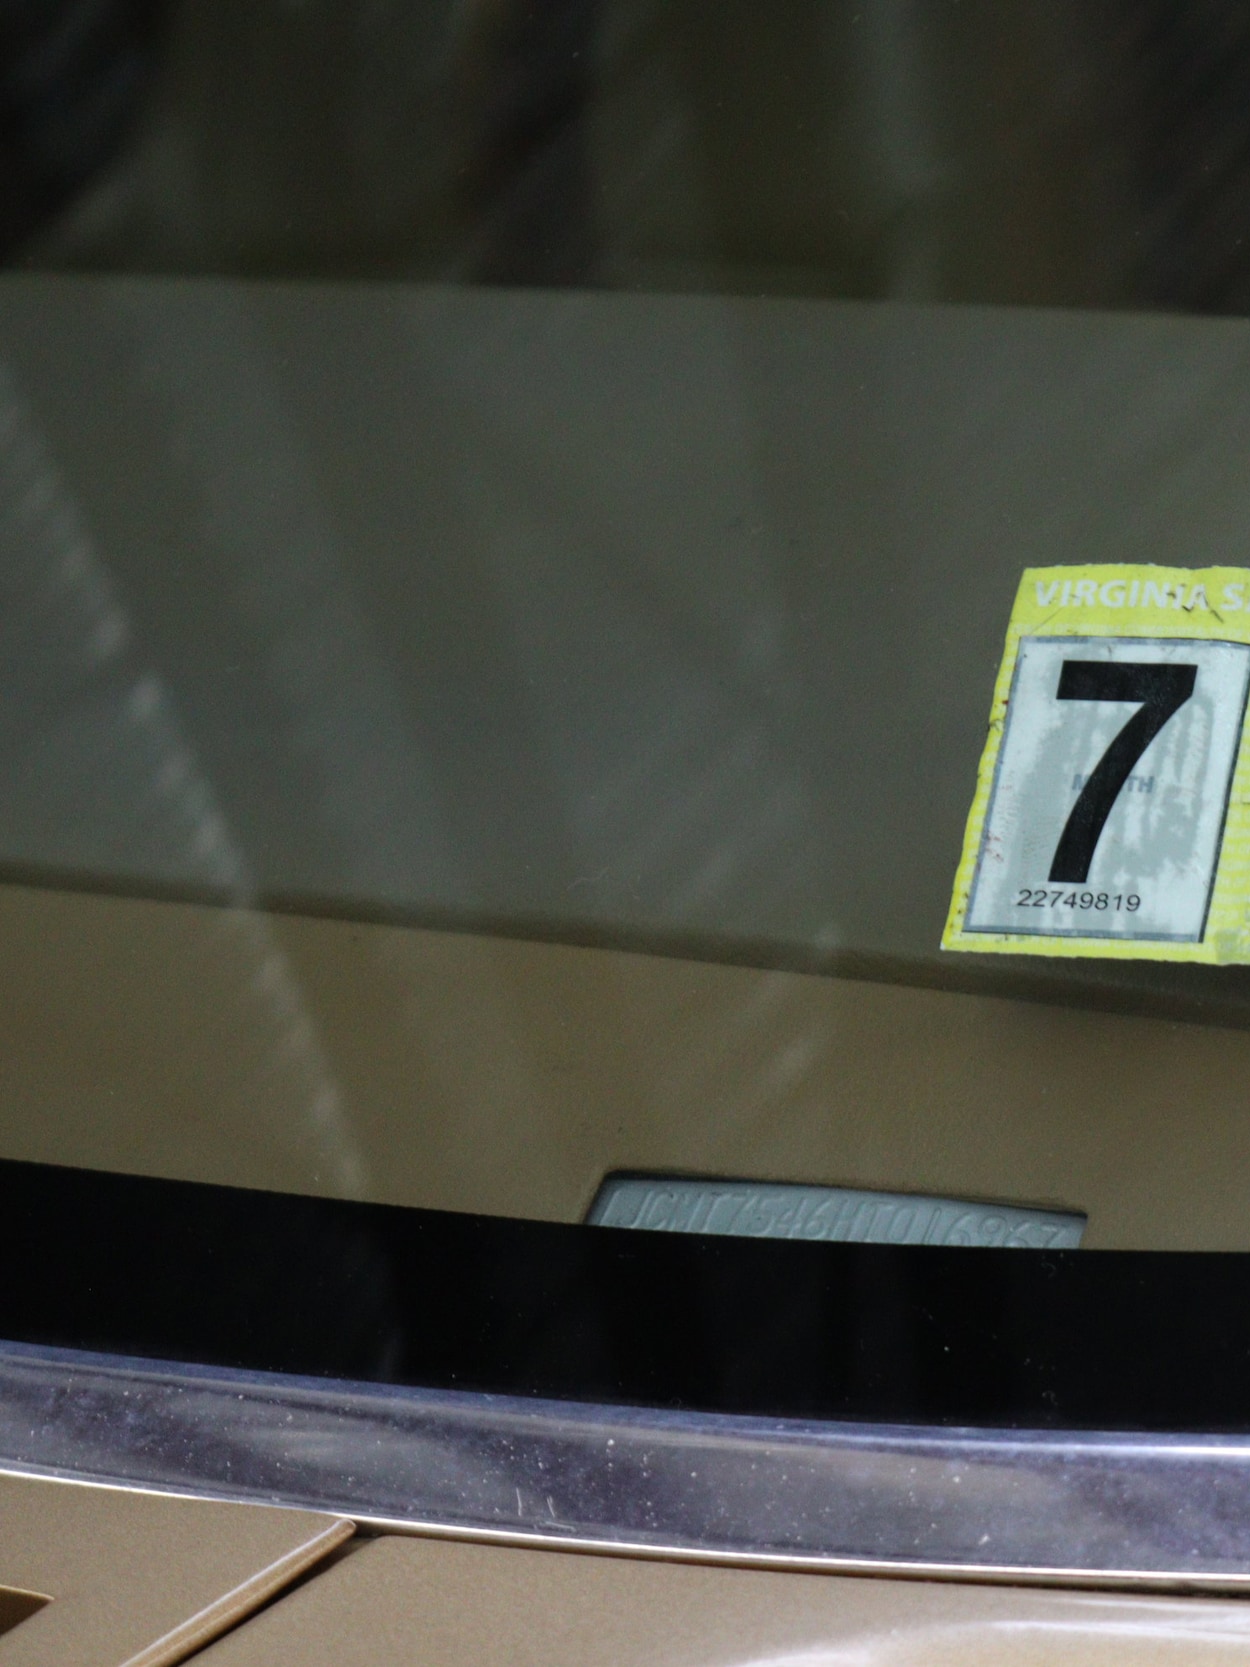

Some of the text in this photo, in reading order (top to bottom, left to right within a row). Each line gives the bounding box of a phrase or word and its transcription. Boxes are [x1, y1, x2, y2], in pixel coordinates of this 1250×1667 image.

[1034, 579, 1209, 612] VIRGINIA
[1048, 660, 1198, 883] 7
[1072, 774, 1155, 793] MTH
[1017, 889, 1141, 912] 22749819
